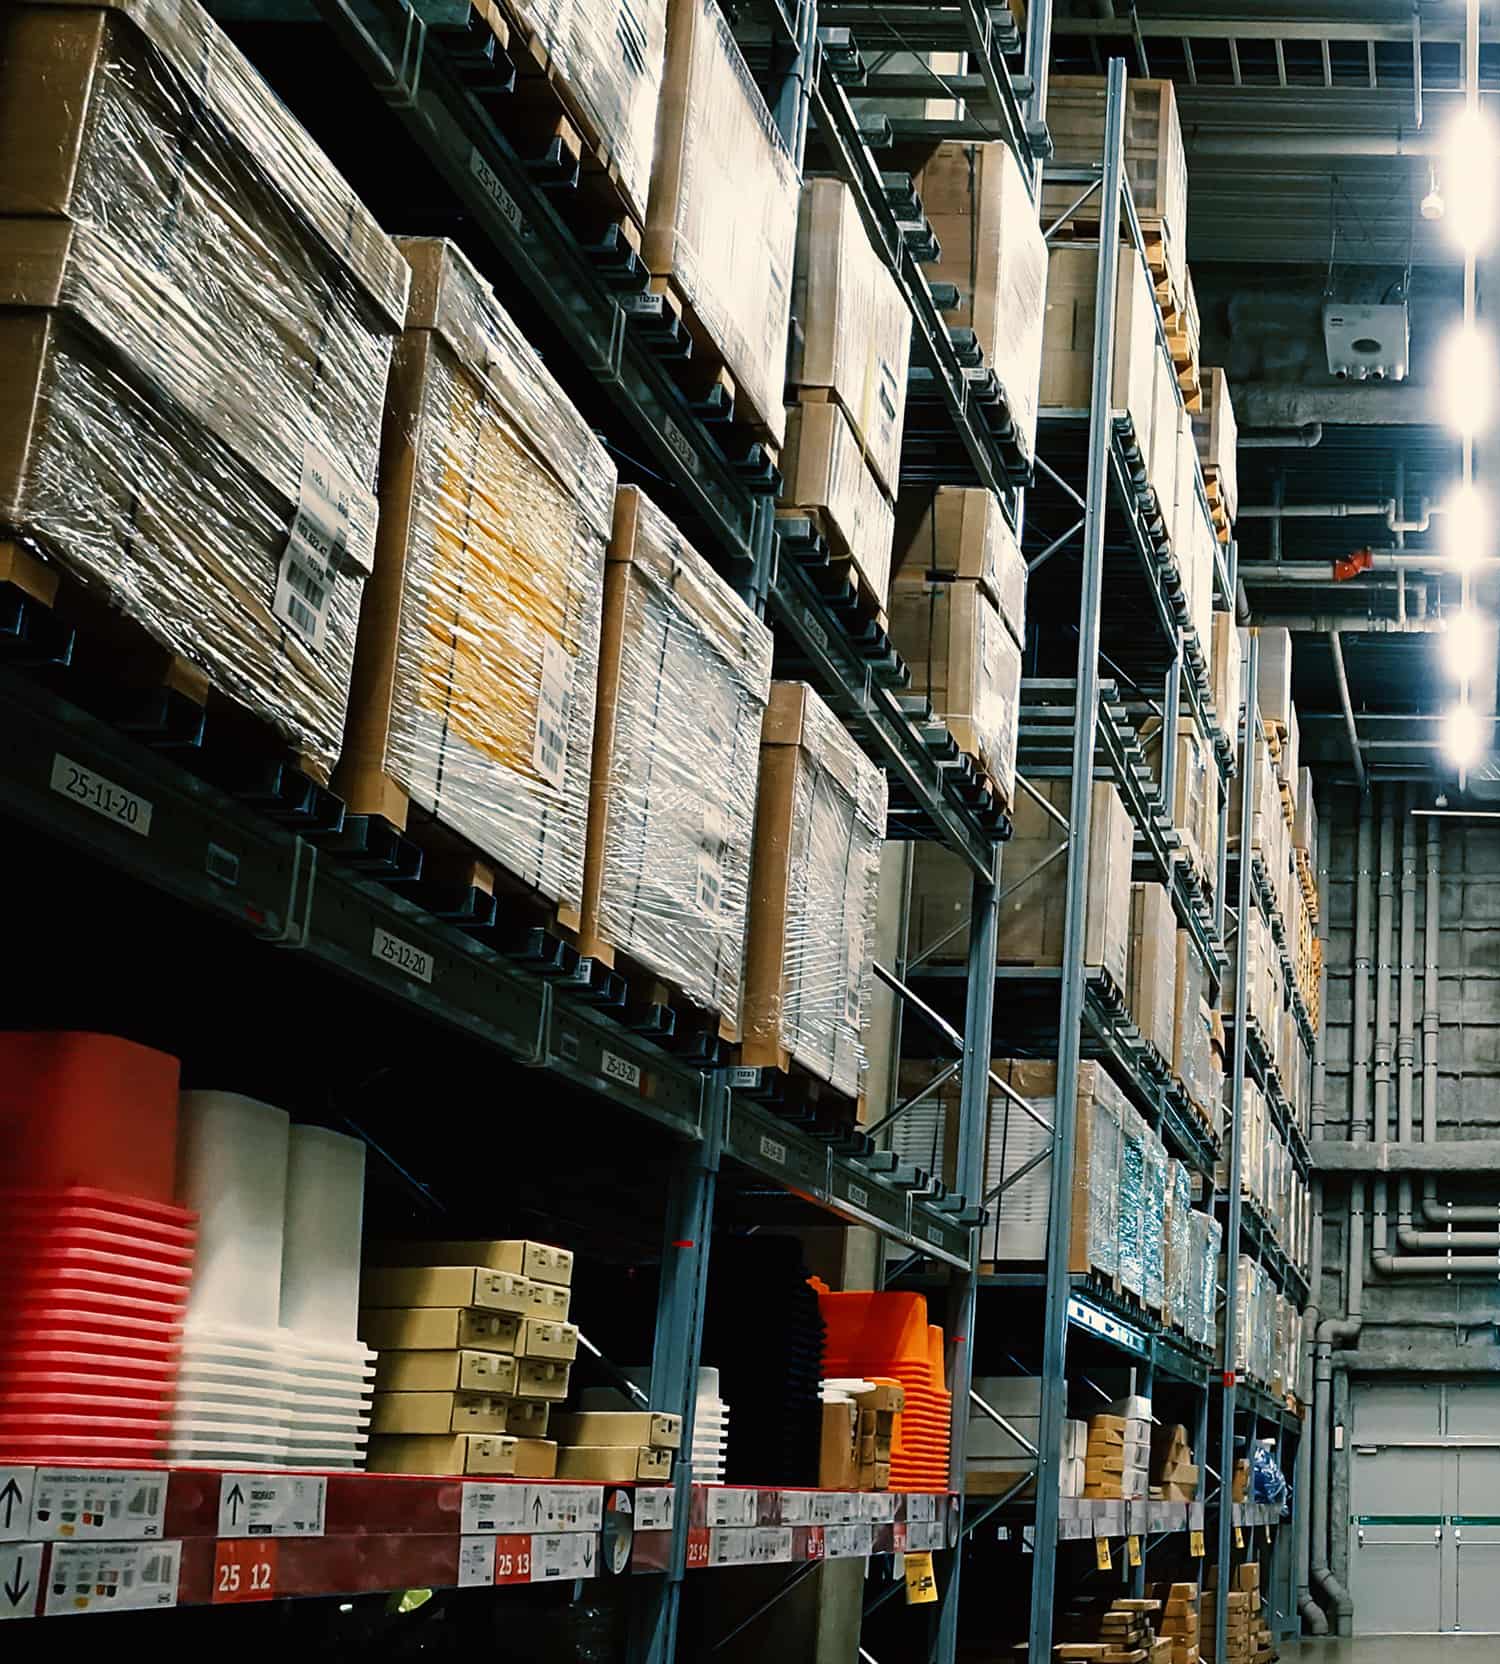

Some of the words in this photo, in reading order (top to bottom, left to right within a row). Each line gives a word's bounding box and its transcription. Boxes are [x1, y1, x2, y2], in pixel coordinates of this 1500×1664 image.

[66, 768, 138, 823] 25-11-20
[382, 936, 425, 975] 25-12-20
[219, 1564, 240, 1591] 25
[250, 1562, 271, 1589] 12
[499, 1554, 512, 1576] 25
[517, 1553, 529, 1574] 13
